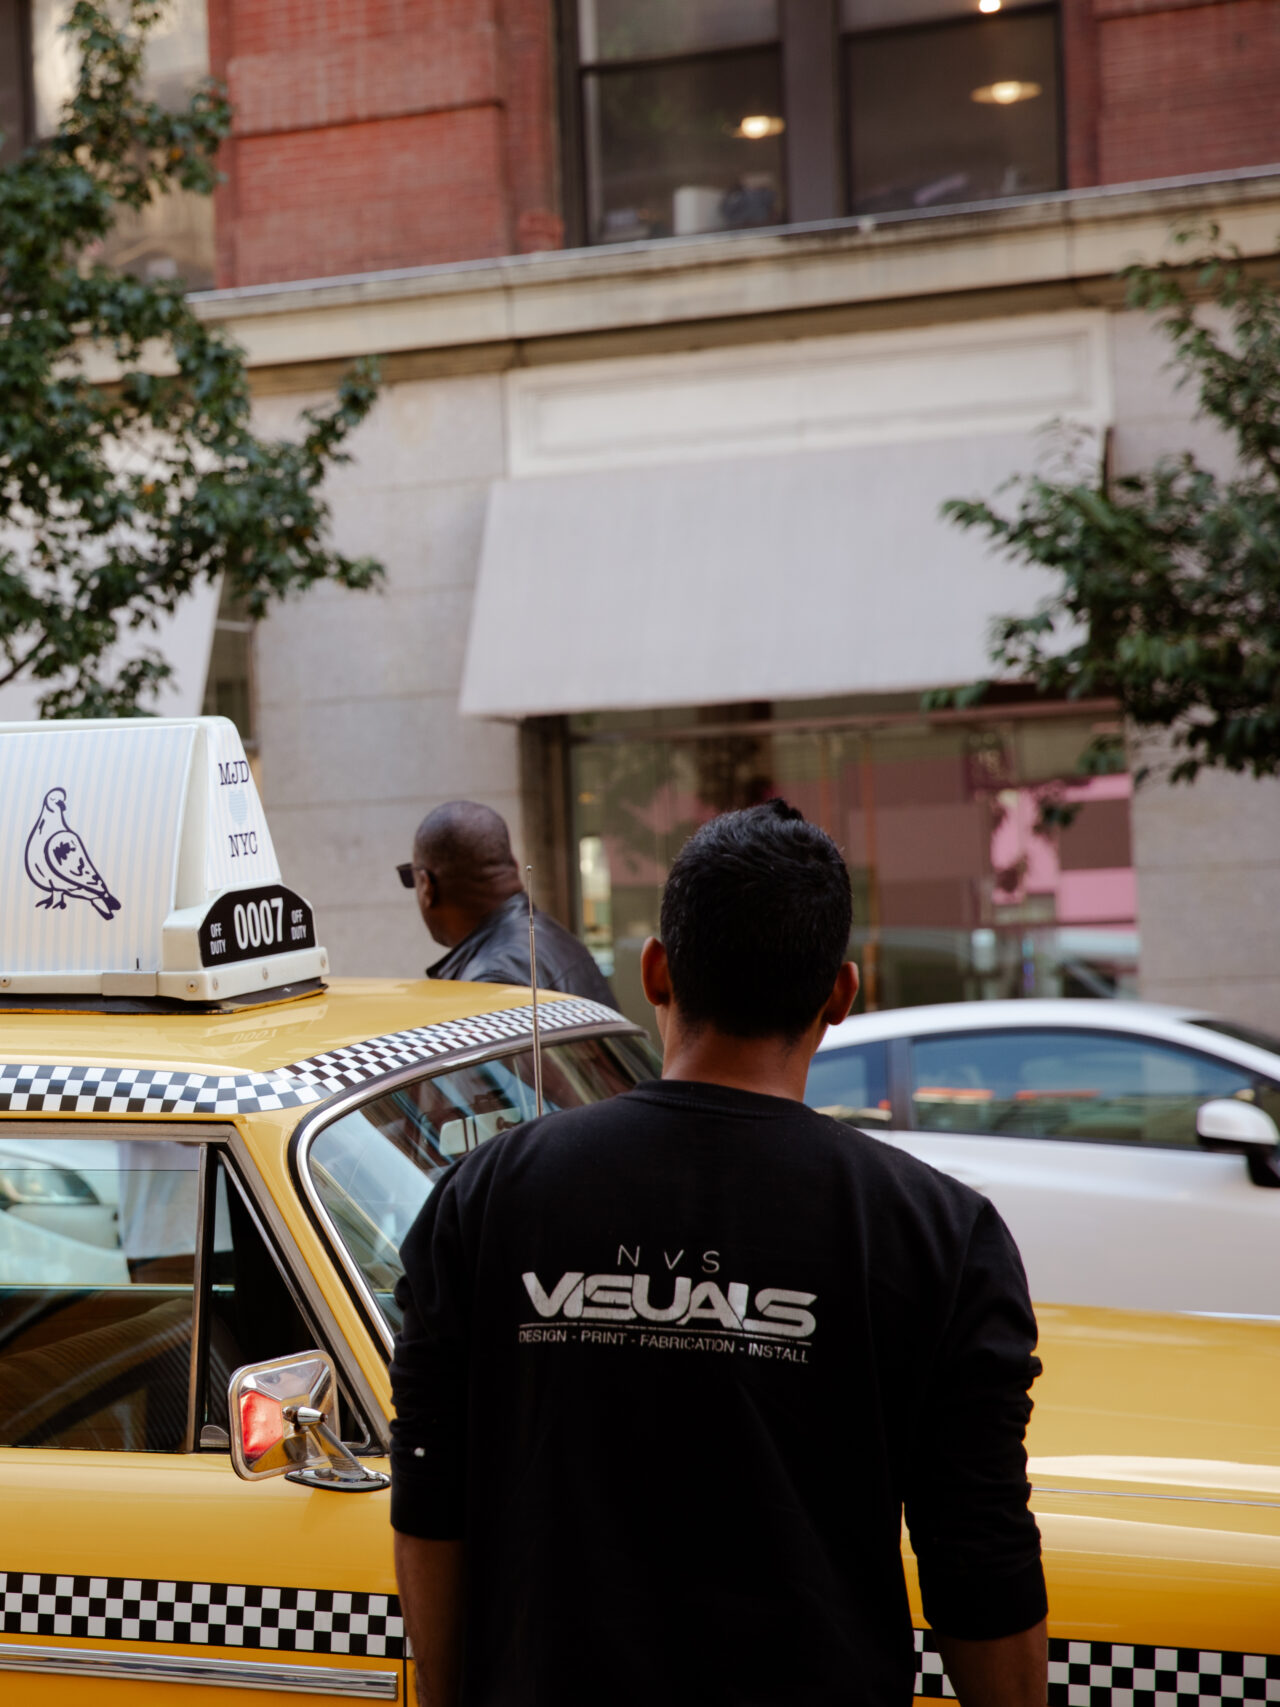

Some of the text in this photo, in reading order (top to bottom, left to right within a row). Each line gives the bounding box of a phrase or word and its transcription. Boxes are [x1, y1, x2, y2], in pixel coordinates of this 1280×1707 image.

[218, 760, 250, 786] MJD
[228, 831, 259, 858] NYC
[233, 897, 284, 950] 0007
[291, 909, 303, 924] OFF
[210, 922, 222, 938] OFF
[291, 925, 307, 941] DUTY
[210, 939, 226, 956] DUTY
[521, 1271, 818, 1339] VISUALS
[519, 1329, 568, 1344] DESIGN
[581, 1330, 627, 1346] PRINT
[639, 1334, 735, 1354] FABRICATION
[748, 1342, 810, 1364] INSTALL
